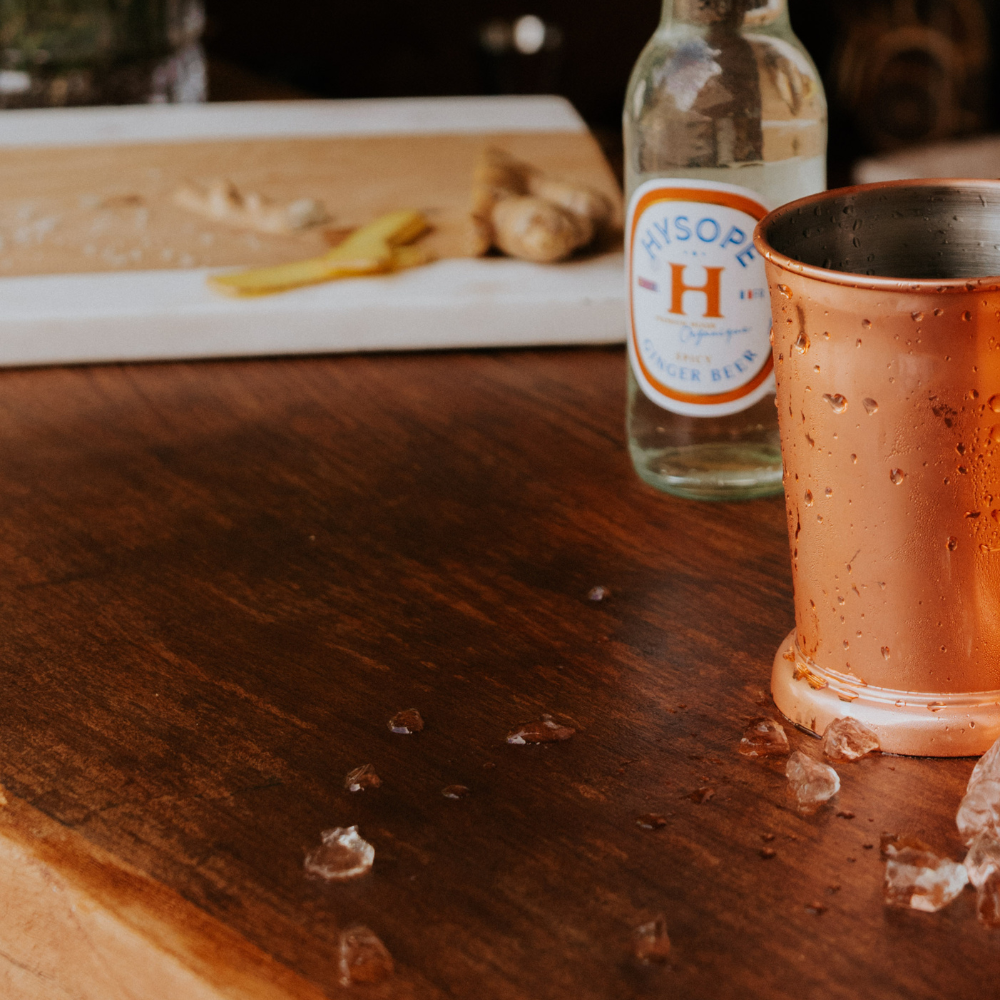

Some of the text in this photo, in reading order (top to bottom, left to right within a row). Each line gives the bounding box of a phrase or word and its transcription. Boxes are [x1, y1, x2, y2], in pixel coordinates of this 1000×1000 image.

[641, 215, 757, 268] HYSOPE
[667, 262, 726, 318] H
[710, 349, 757, 382] BEER
